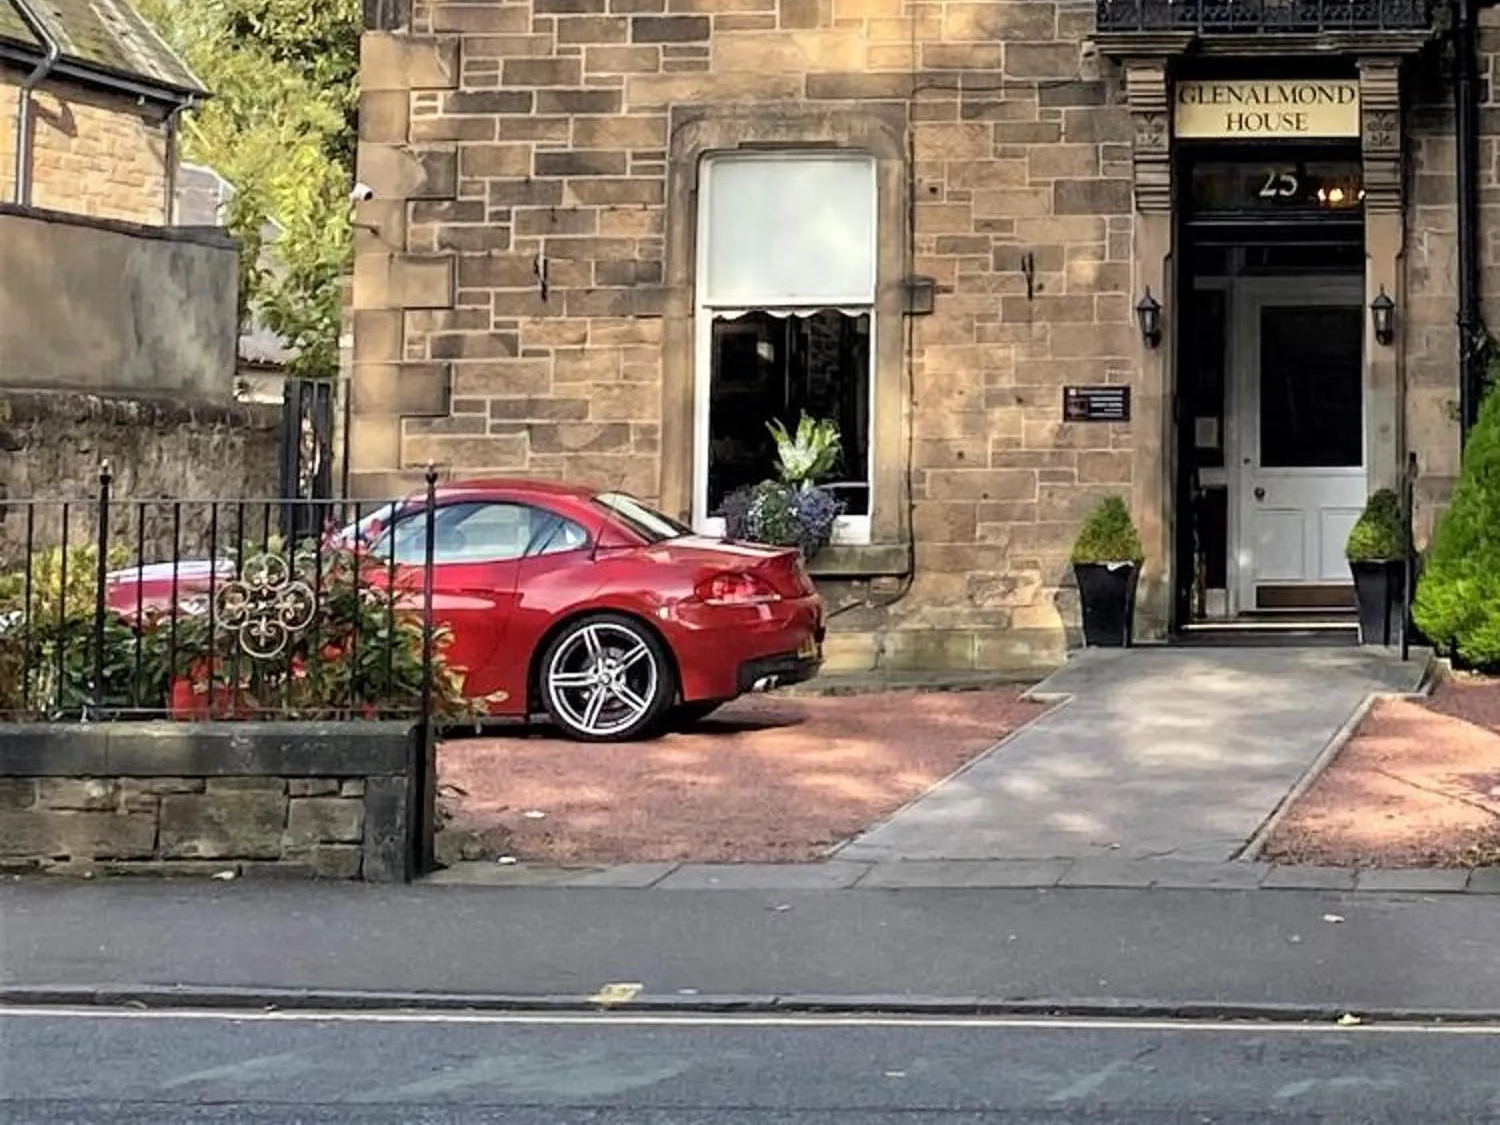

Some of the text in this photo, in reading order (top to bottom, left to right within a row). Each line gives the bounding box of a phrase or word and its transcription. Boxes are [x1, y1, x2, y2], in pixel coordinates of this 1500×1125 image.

[1179, 84, 1355, 106] GLENALMOND
[1226, 112, 1309, 132] HOUSE
[1258, 170, 1298, 197] 25
